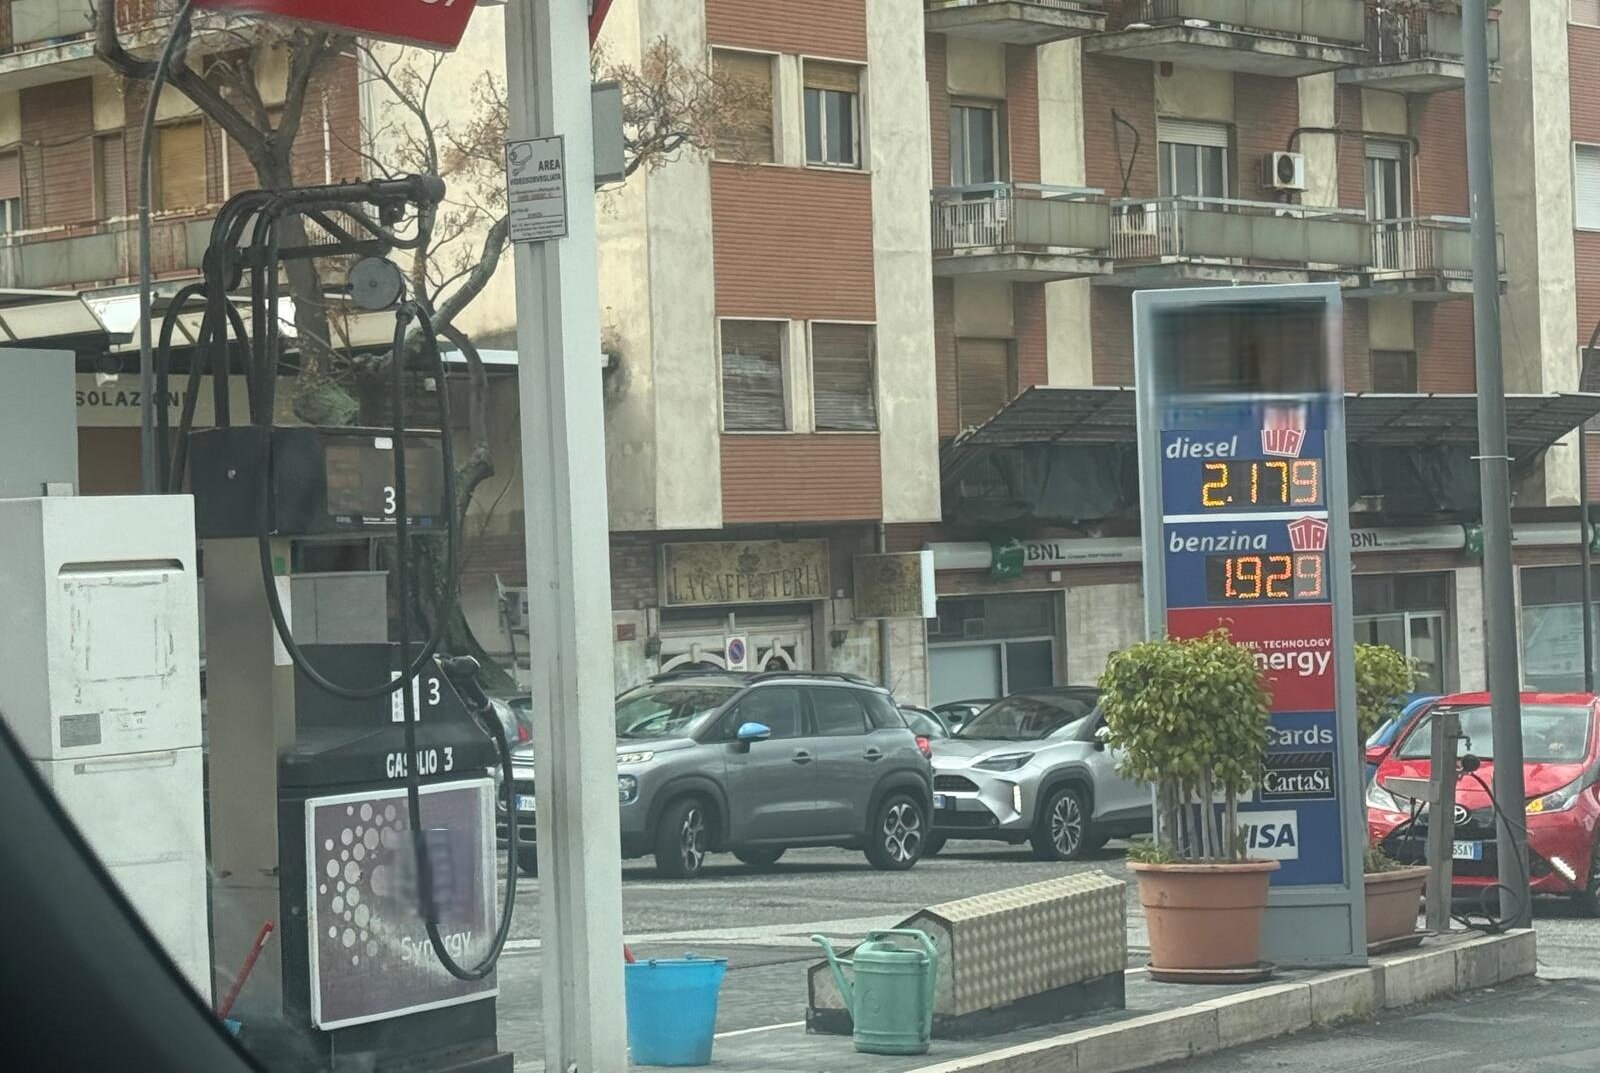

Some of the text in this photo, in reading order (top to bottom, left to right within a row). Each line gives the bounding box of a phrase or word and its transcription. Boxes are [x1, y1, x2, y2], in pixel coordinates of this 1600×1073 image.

[538, 159, 561, 172] AREA
[75, 391, 187, 406] SOLAZN
[1166, 436, 1238, 459] diesel
[1202, 460, 1317, 507] 2.179
[383, 486, 396, 514] 3
[1026, 543, 1066, 560] BNL
[1169, 530, 1268, 553] benzina
[1350, 532, 1382, 548] BNL
[1263, 638, 1331, 649] TECHNOLOGY
[1253, 651, 1331, 676] nergy
[428, 677, 440, 705] 3
[444, 747, 454, 772] 3
[1246, 823, 1296, 849] ISA
[401, 931, 472, 966] Synrgy
